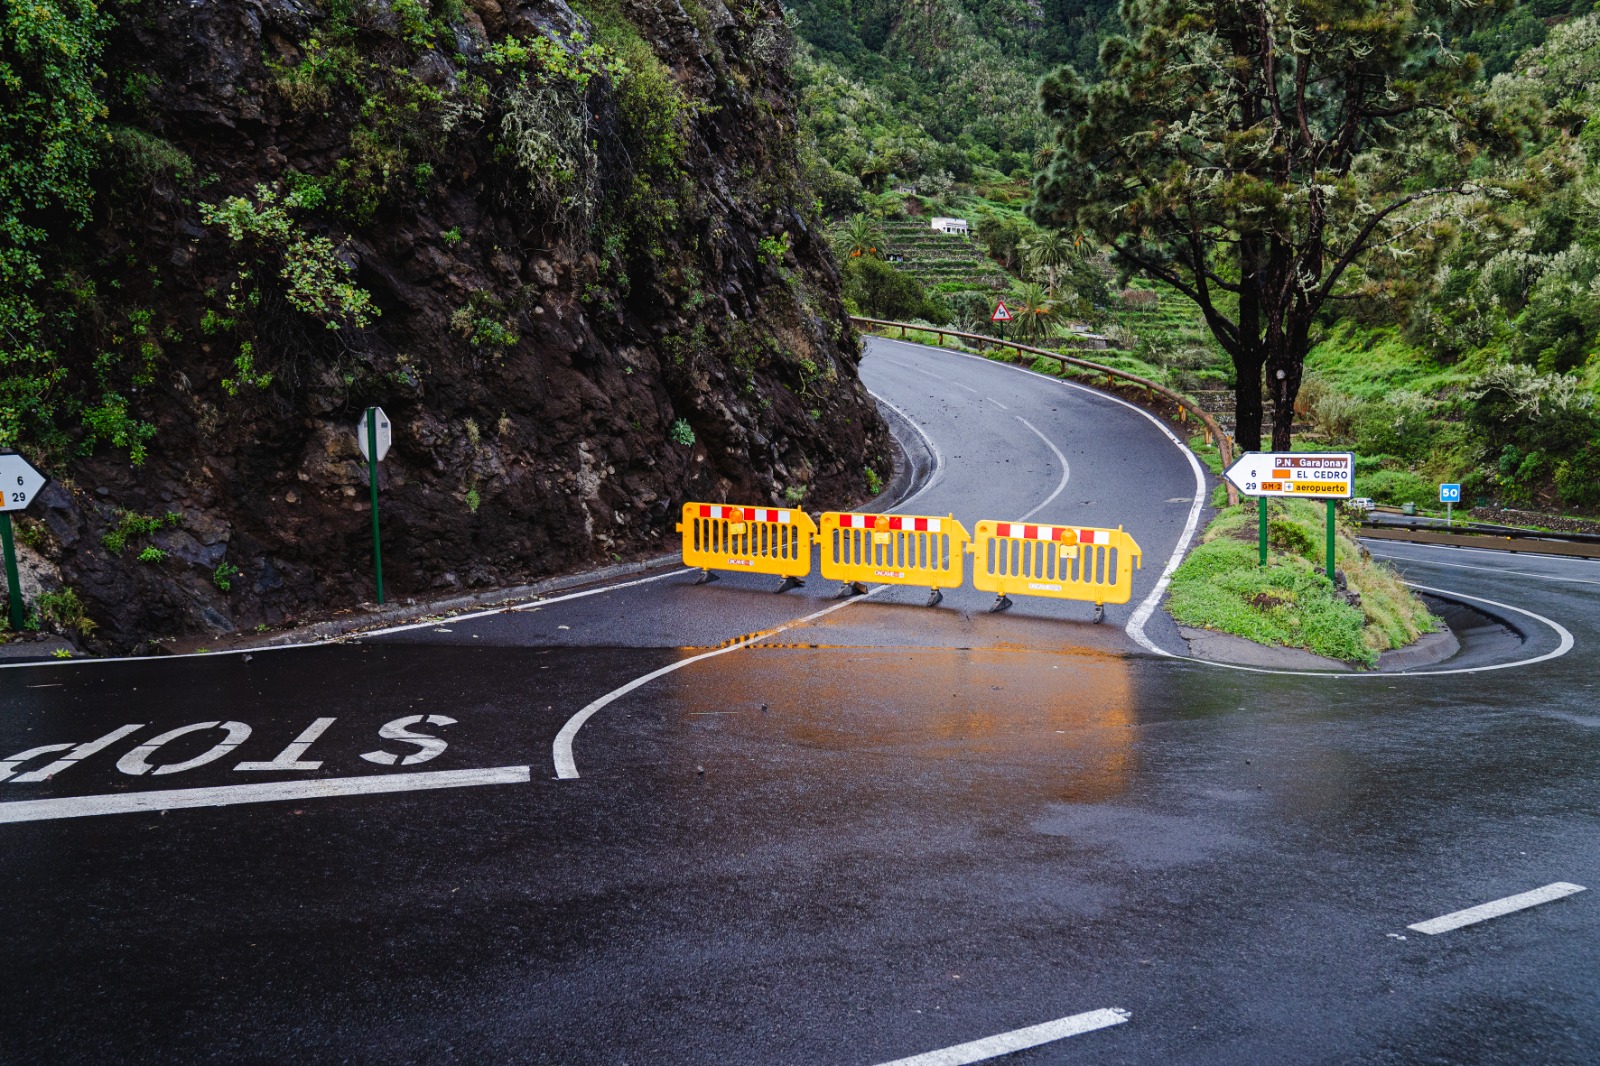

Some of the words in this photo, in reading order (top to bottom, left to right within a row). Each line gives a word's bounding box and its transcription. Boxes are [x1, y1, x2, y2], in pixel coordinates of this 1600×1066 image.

[1276, 459, 1295, 467] P.N.
[1299, 459, 1347, 468] Garajonay
[1251, 470, 1257, 478] 6
[1297, 471, 1308, 479] EL
[1313, 471, 1348, 479] CEDRO
[17, 475, 24, 486] 6
[1245, 482, 1257, 490] 29
[1295, 484, 1345, 493] aeropuerto
[1442, 488, 1458, 497] 50
[12, 492, 26, 502] 29
[0, 713, 459, 783] STOP
